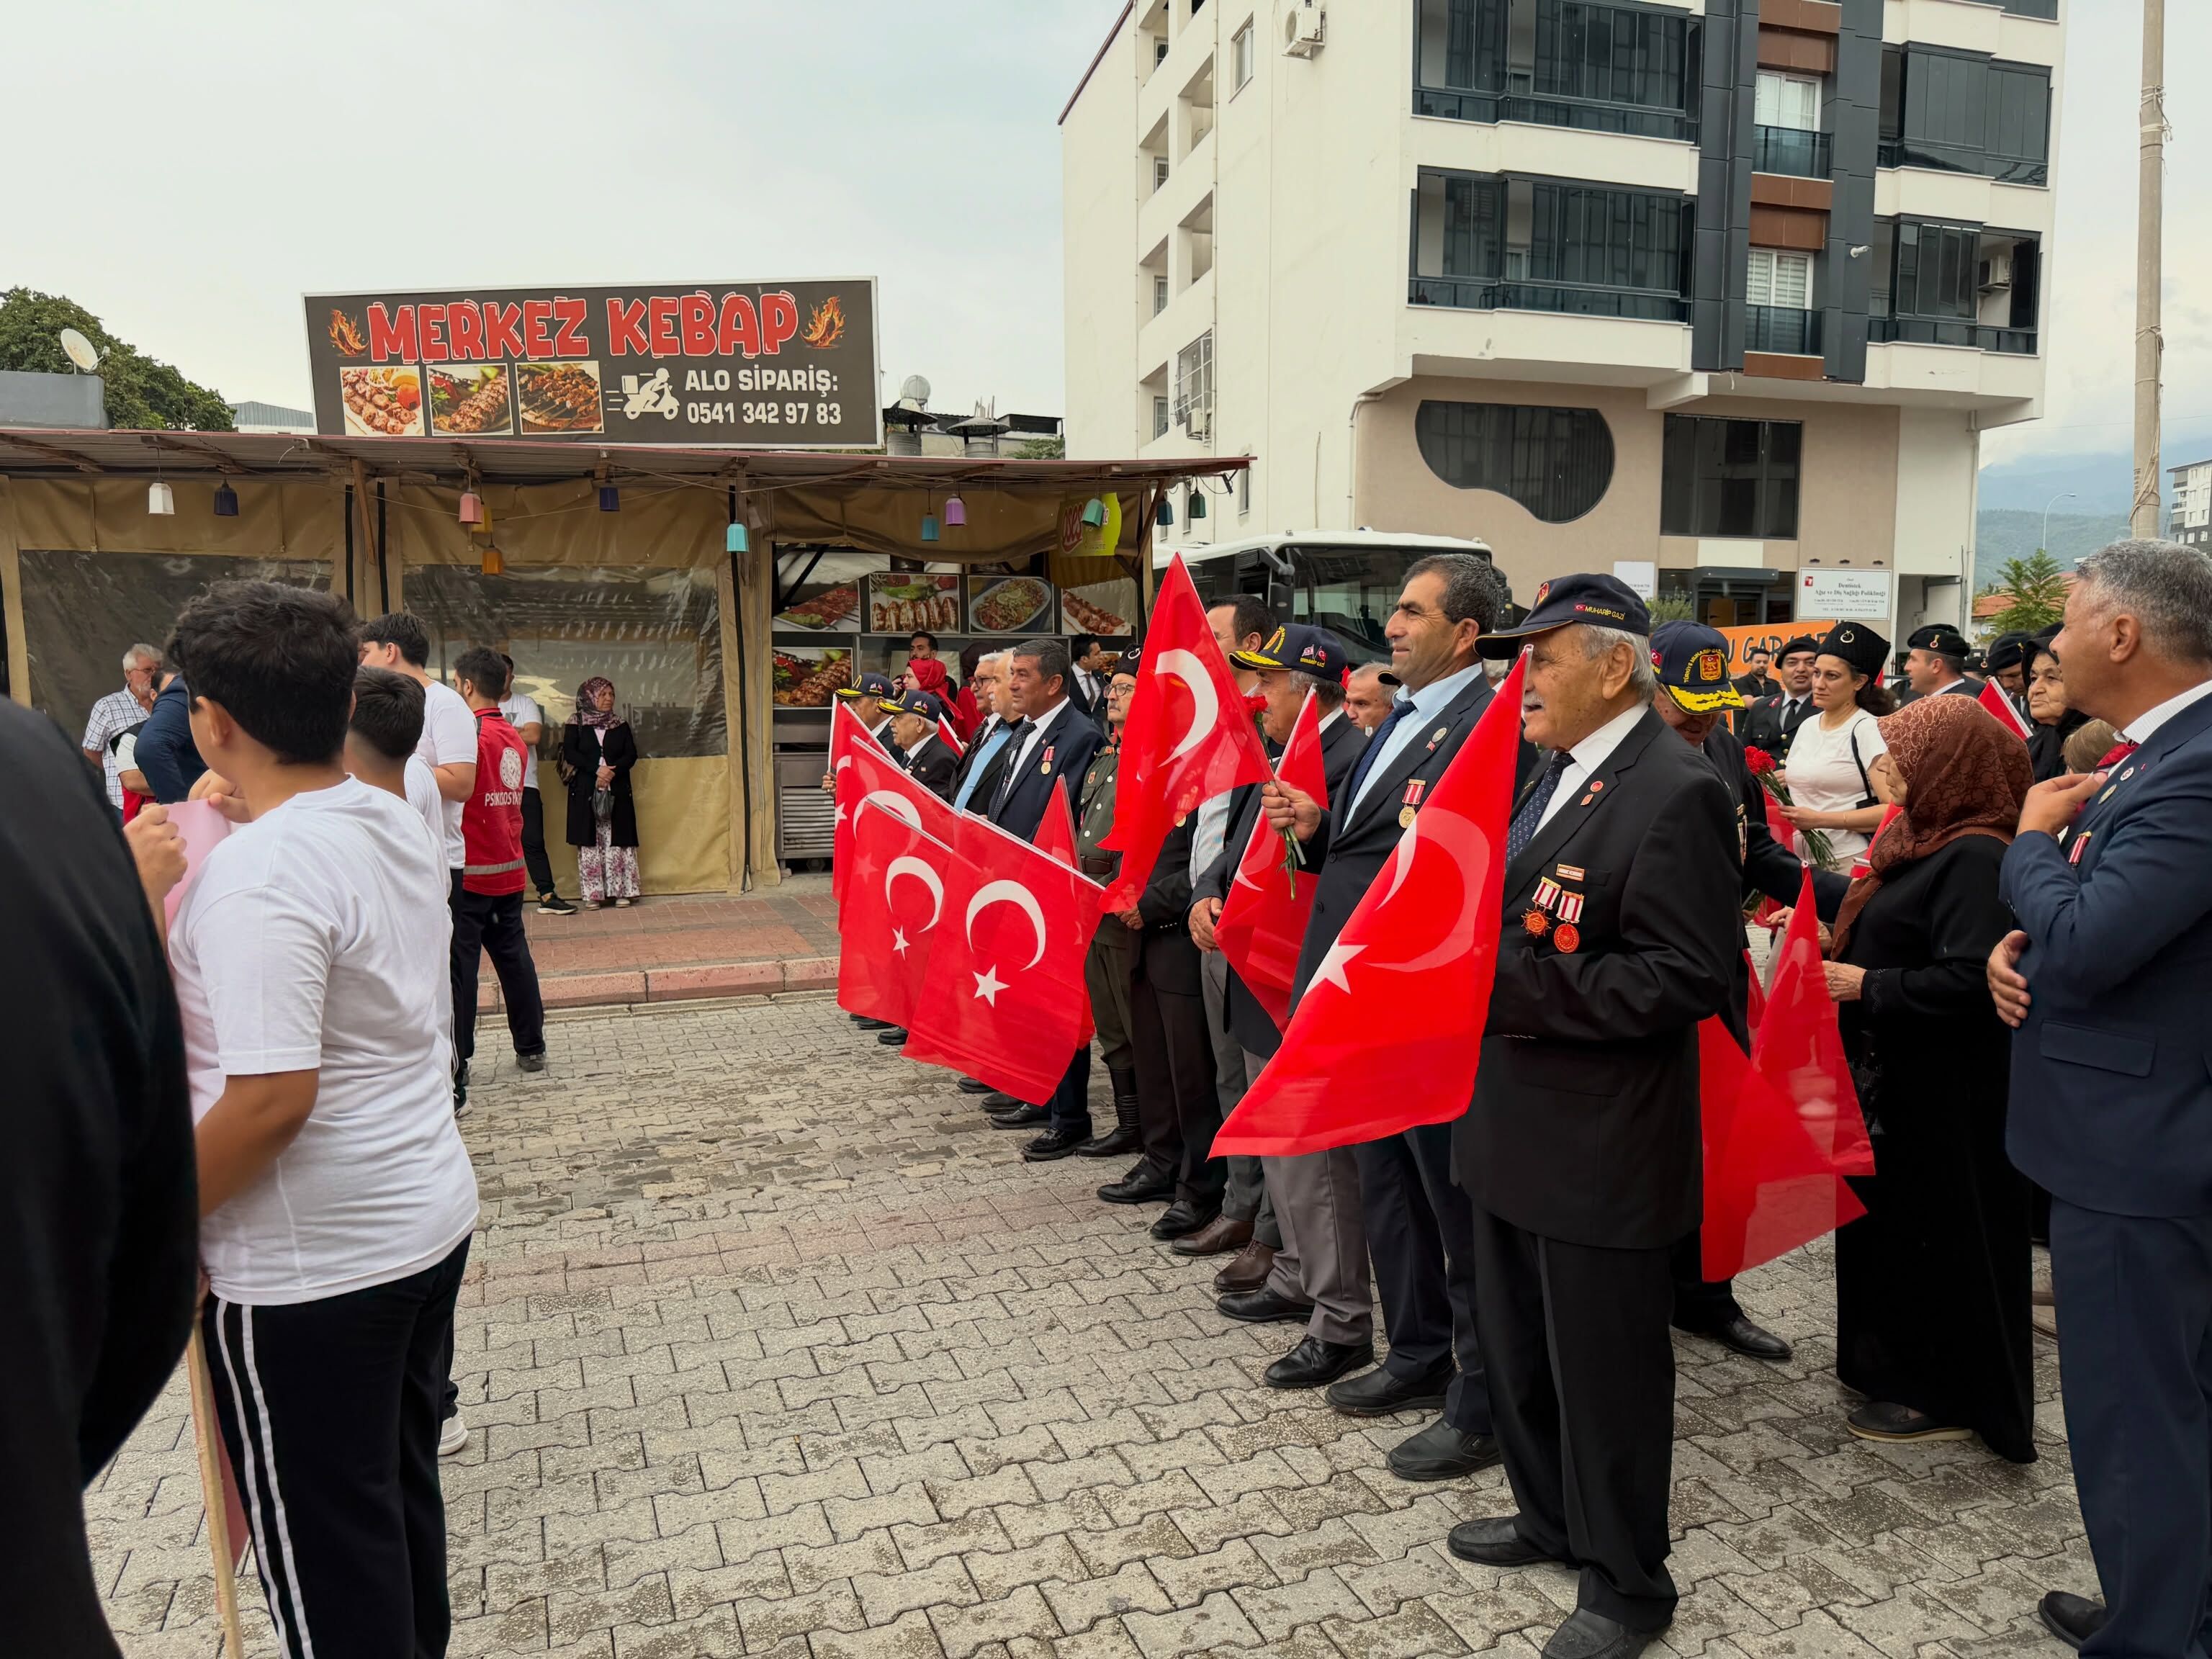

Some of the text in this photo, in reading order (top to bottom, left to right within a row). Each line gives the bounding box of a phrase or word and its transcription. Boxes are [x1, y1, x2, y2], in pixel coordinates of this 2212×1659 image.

[367, 290, 799, 364] MERKEZ KEBAP
[685, 364, 838, 397] ALO SİPARİŞ:
[687, 402, 842, 425] 0541 342 97 83
[1585, 606, 1626, 621] MUHARİP GAZİ
